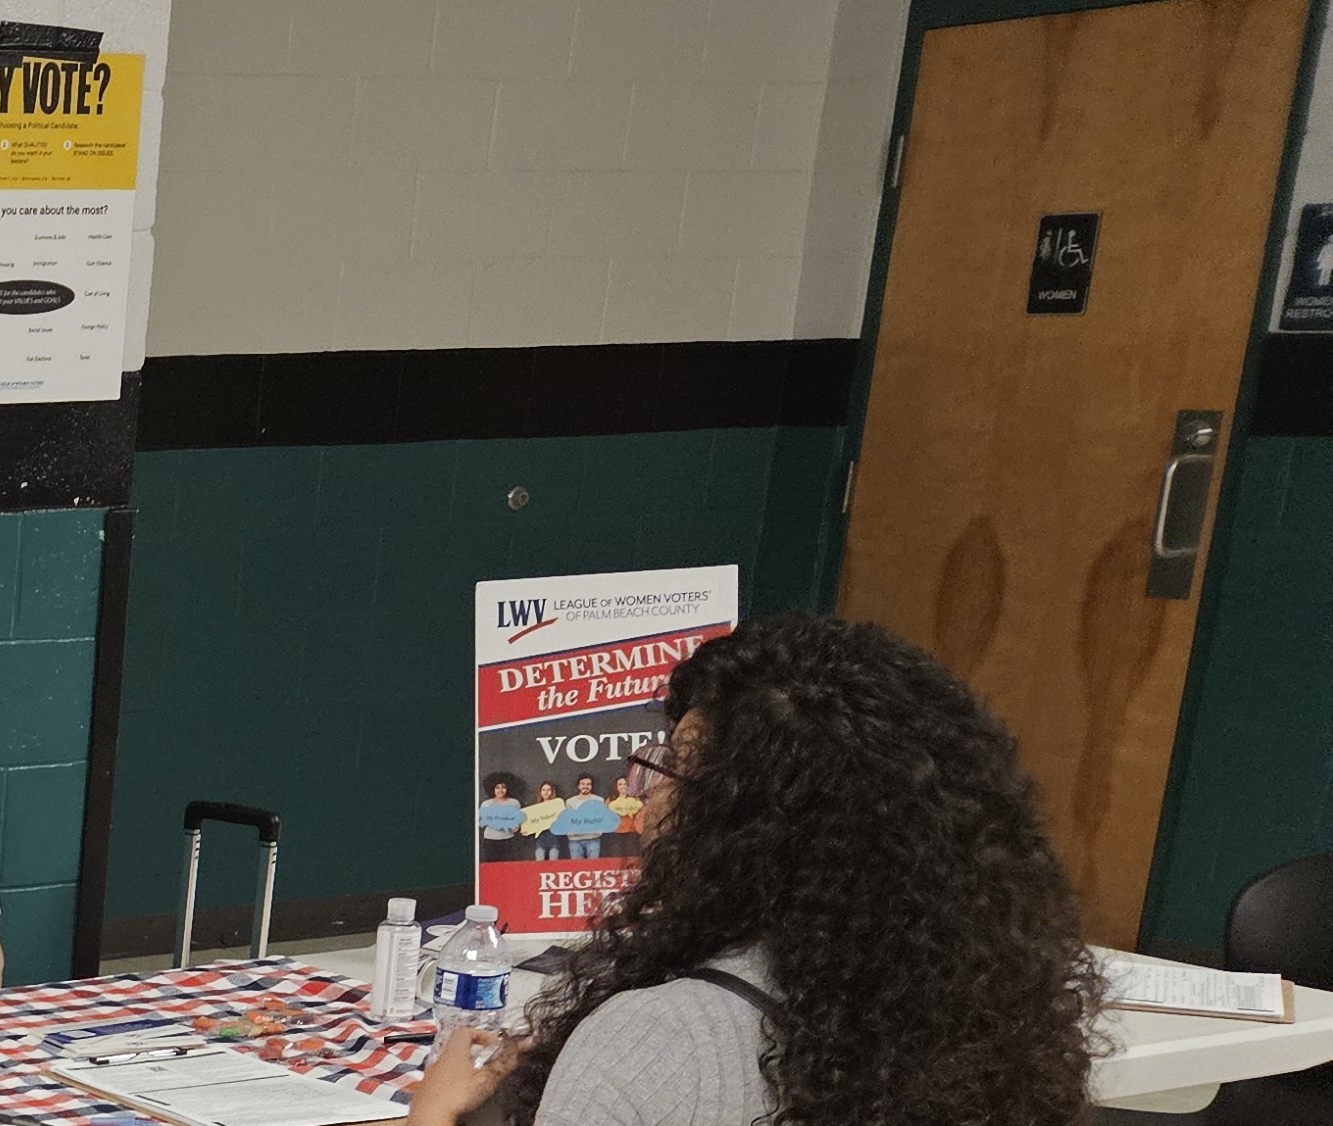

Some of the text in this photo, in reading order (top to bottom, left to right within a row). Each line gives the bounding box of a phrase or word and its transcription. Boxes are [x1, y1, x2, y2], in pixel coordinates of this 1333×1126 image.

[22, 61, 111, 115] VOTE?
[1, 207, 17, 218] you
[19, 207, 37, 216] care
[39, 205, 64, 215] about
[66, 205, 79, 215] the
[81, 204, 109, 215] most?
[1038, 289, 1077, 301] WOMEN
[553, 598, 598, 611] LEAGUE
[614, 594, 662, 607] WOMEN
[497, 598, 547, 628] LWV
[565, 603, 701, 622] OF PALM BEACH COUNTY
[537, 686, 579, 712] the
[570, 818, 583, 826] My
